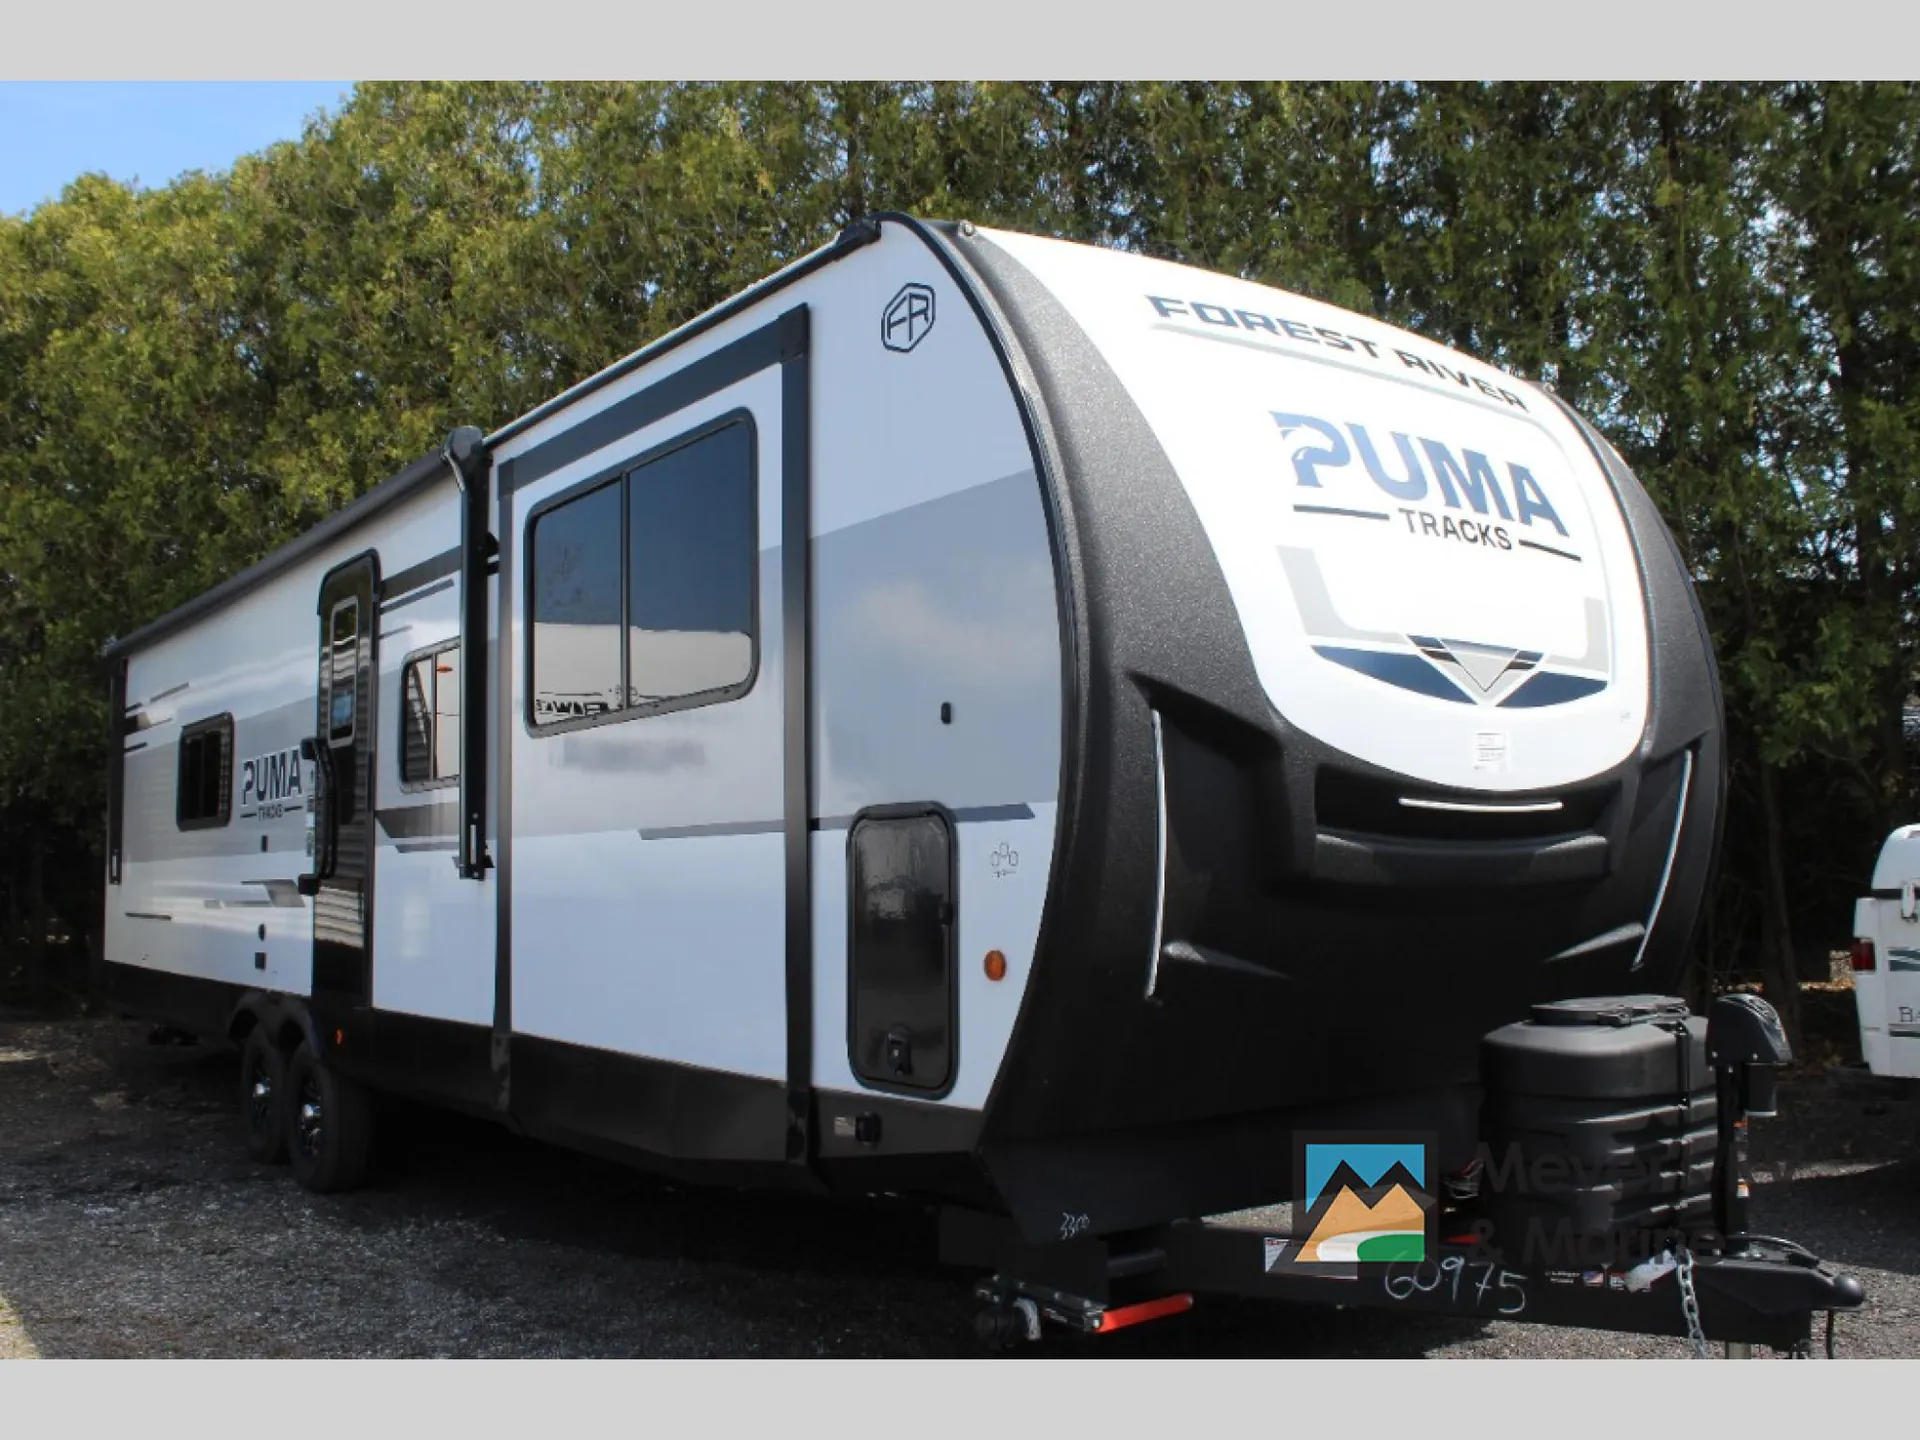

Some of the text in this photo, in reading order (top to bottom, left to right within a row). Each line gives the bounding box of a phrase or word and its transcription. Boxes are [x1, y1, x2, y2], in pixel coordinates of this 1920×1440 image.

[1145, 295, 1529, 412] FOREST RIVER
[1268, 410, 1570, 538] PUMA
[1398, 507, 1513, 551] TRACKS
[241, 748, 303, 806] PUMA
[1384, 1250, 1528, 1314] 60975
